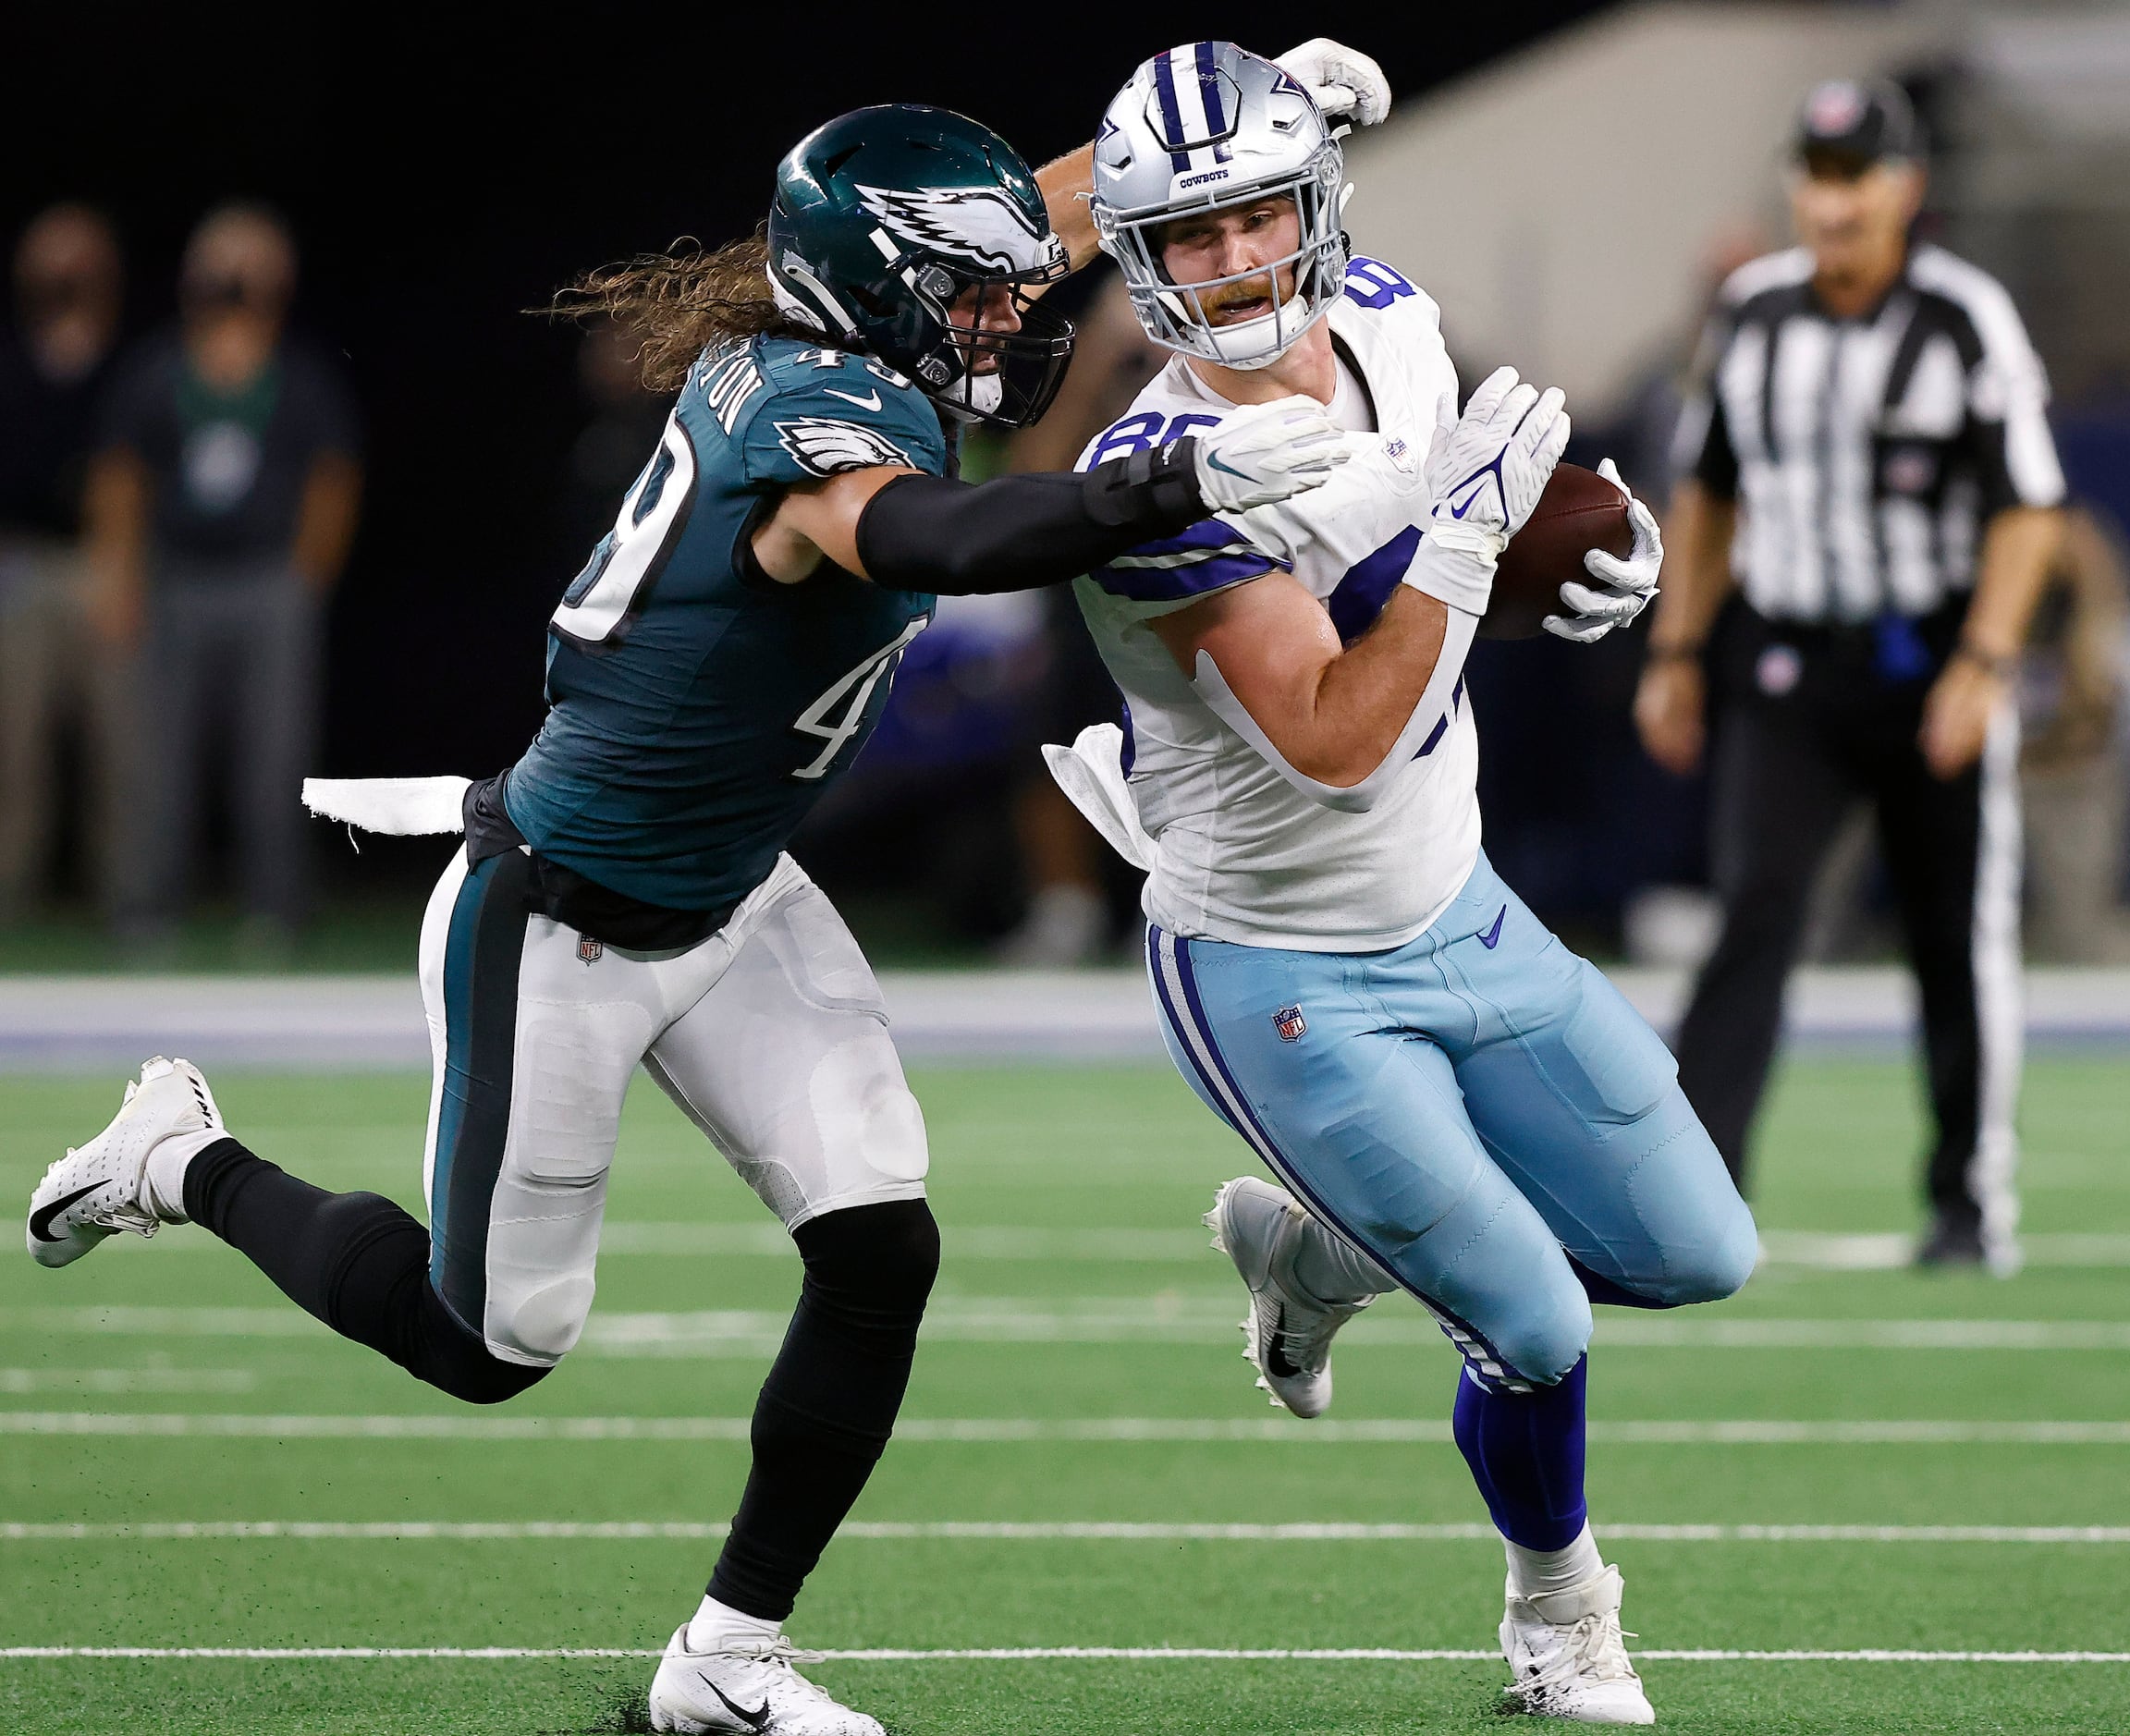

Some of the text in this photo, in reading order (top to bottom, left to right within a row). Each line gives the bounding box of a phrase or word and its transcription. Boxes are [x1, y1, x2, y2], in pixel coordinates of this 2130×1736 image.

[1180, 169, 1229, 189] COWBOYS
[700, 336, 765, 436] TON
[791, 614, 928, 778] 4
[581, 943, 600, 958] NFL
[1279, 1019, 1304, 1037] NFL
